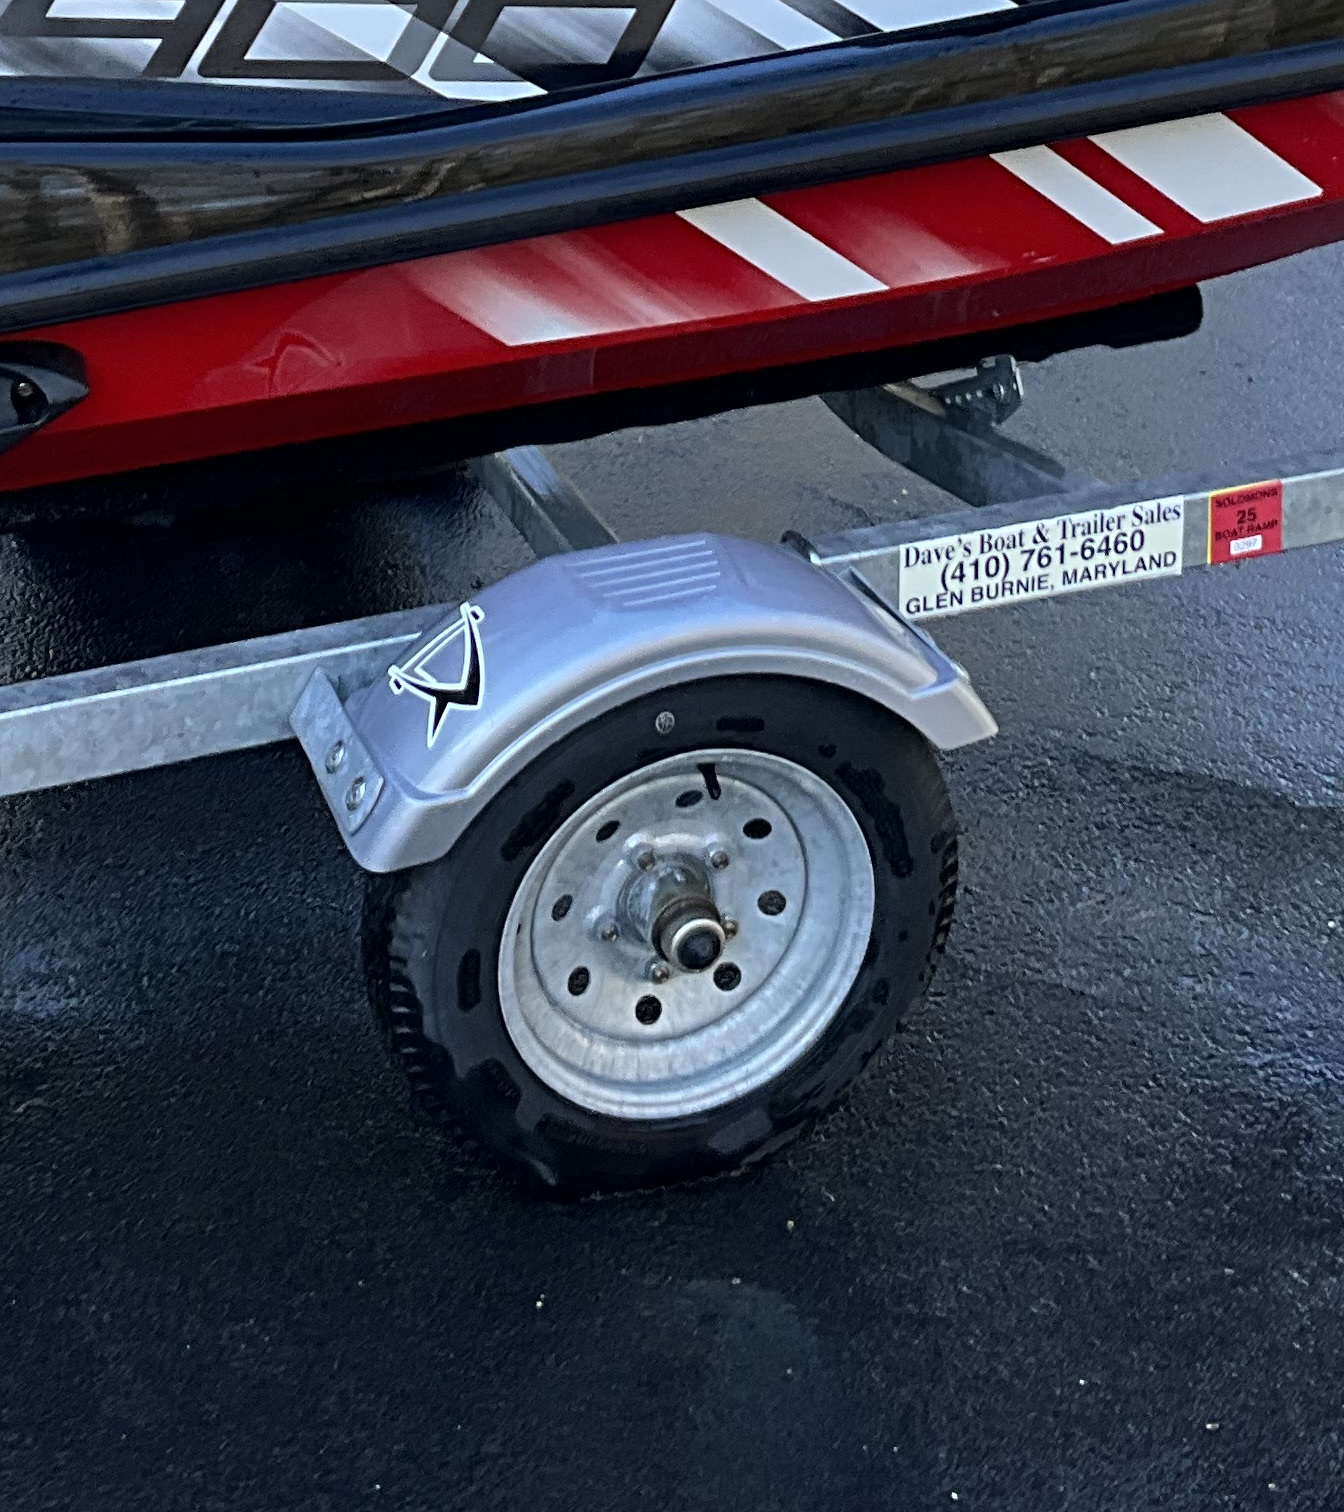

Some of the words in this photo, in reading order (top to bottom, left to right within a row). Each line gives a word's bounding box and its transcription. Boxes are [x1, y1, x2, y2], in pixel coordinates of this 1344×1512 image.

[904, 537, 972, 568] Dave's
[979, 526, 1025, 554] Boat
[1032, 521, 1050, 545] &
[1057, 509, 1126, 540] Trailer
[1131, 502, 1181, 527] Sales
[1215, 527, 1243, 541] BOAT
[1236, 507, 1257, 525] 25
[905, 590, 964, 614] GLEN
[971, 574, 1055, 602] BURNIE,
[1062, 550, 1177, 587] MARYLAND
[941, 552, 1010, 591] (410)
[1022, 529, 1145, 571] 761-6460
